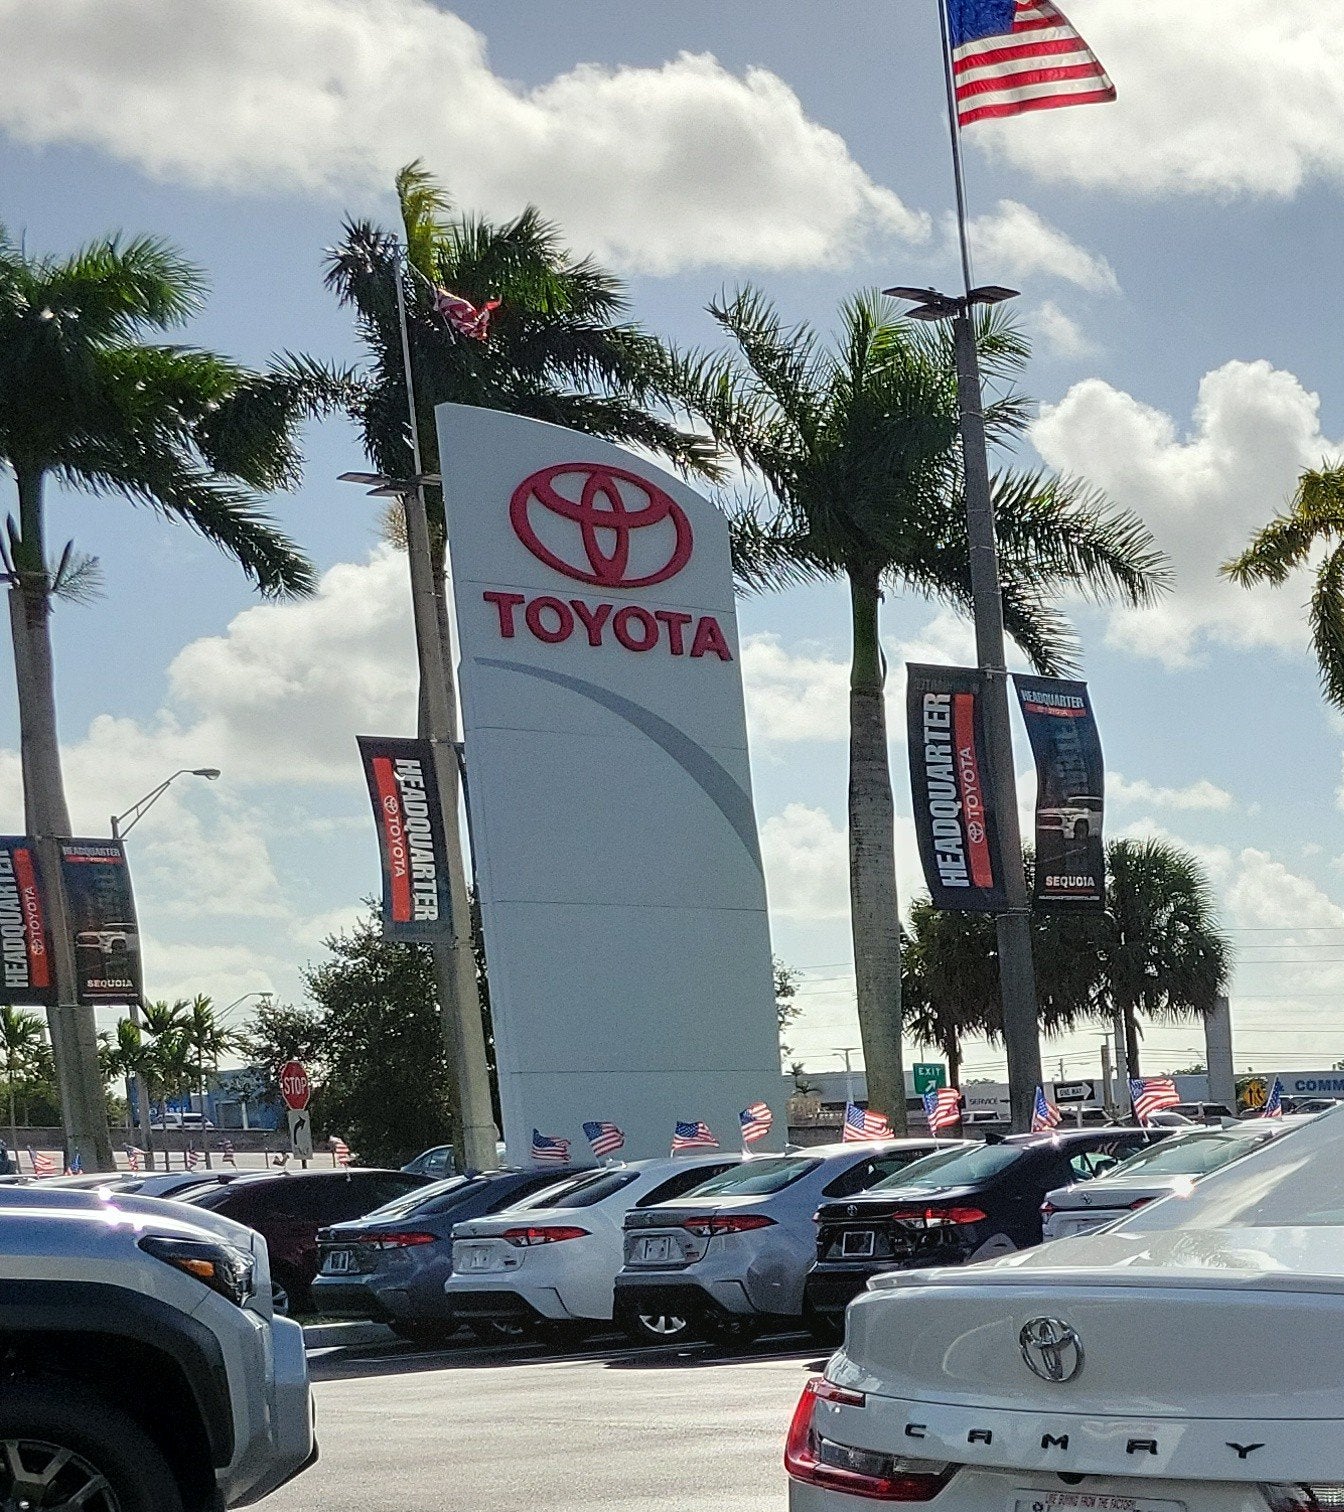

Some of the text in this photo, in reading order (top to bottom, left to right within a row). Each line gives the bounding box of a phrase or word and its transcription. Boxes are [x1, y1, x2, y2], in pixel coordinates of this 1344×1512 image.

[483, 591, 733, 662] TOYOTA
[1021, 690, 1085, 708] HEADQUARTER
[924, 693, 970, 887] HEADQUARTER
[959, 747, 984, 819] TOYOTA
[388, 817, 406, 878] TOYOTA
[395, 758, 439, 922] HEADQUARTER
[1046, 875, 1095, 888] SEQUOIA
[25, 887, 41, 938] TOYOTA
[87, 979, 133, 988] SEQUOIA
[284, 1076, 307, 1095] STOP
[917, 1067, 940, 1077] EXIT
[969, 1097, 998, 1105] SERVICE
[1060, 1088, 1082, 1097] ONE WAY
[905, 1423, 1266, 1459] CAMRY
